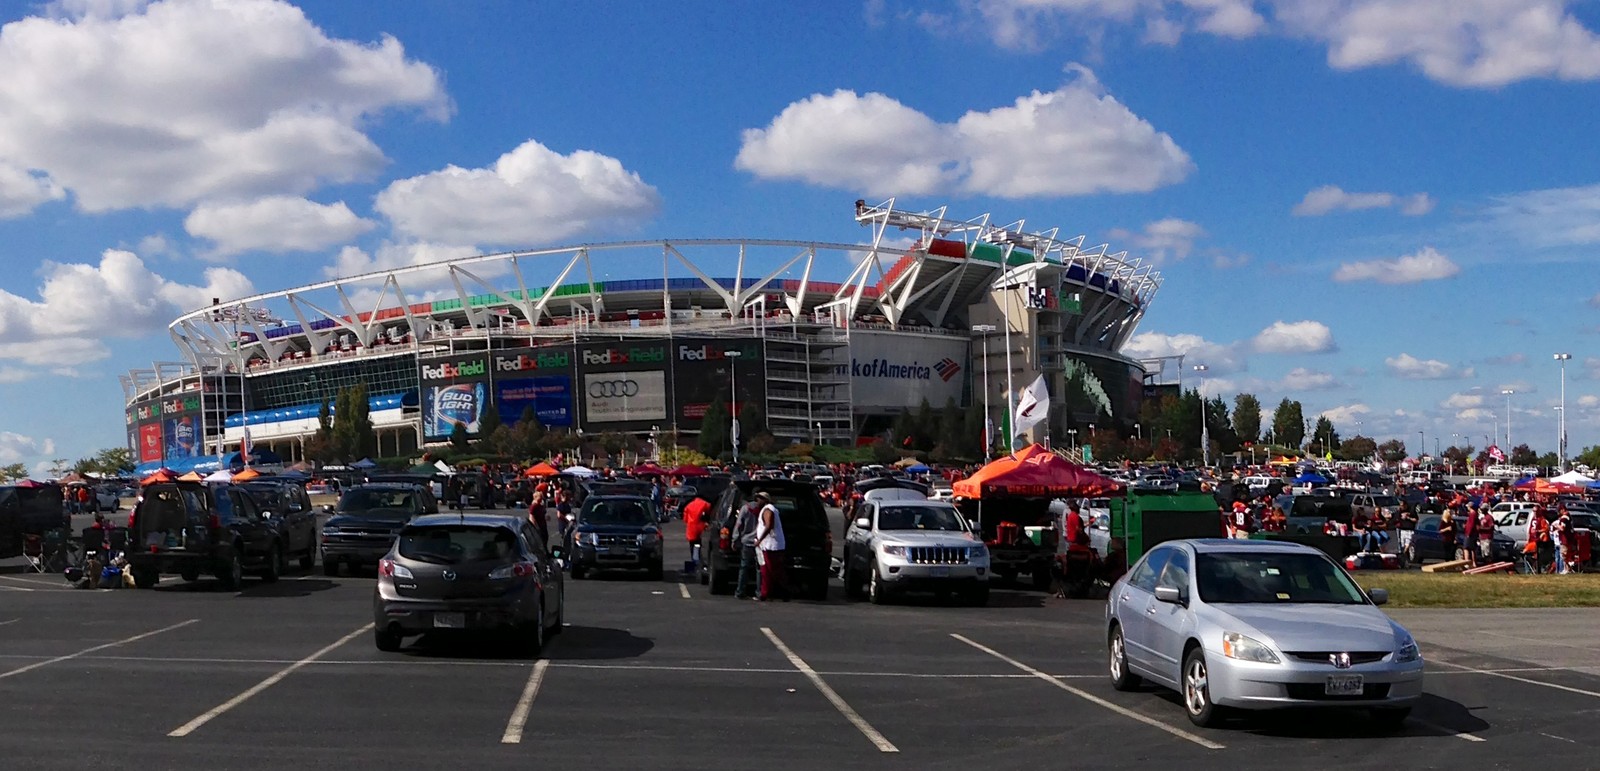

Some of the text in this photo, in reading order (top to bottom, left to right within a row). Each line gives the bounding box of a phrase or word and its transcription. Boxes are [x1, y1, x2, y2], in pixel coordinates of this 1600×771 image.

[1026, 286, 1082, 314] FedExField
[496, 351, 569, 372] FedExField
[583, 347, 665, 365] FedExField
[422, 359, 485, 380] FedExField
[862, 359, 878, 377] of
[879, 359, 930, 379] America
[438, 401, 474, 410] LIGHT
[441, 392, 472, 402] BUD
[1235, 512, 1245, 526] 18
